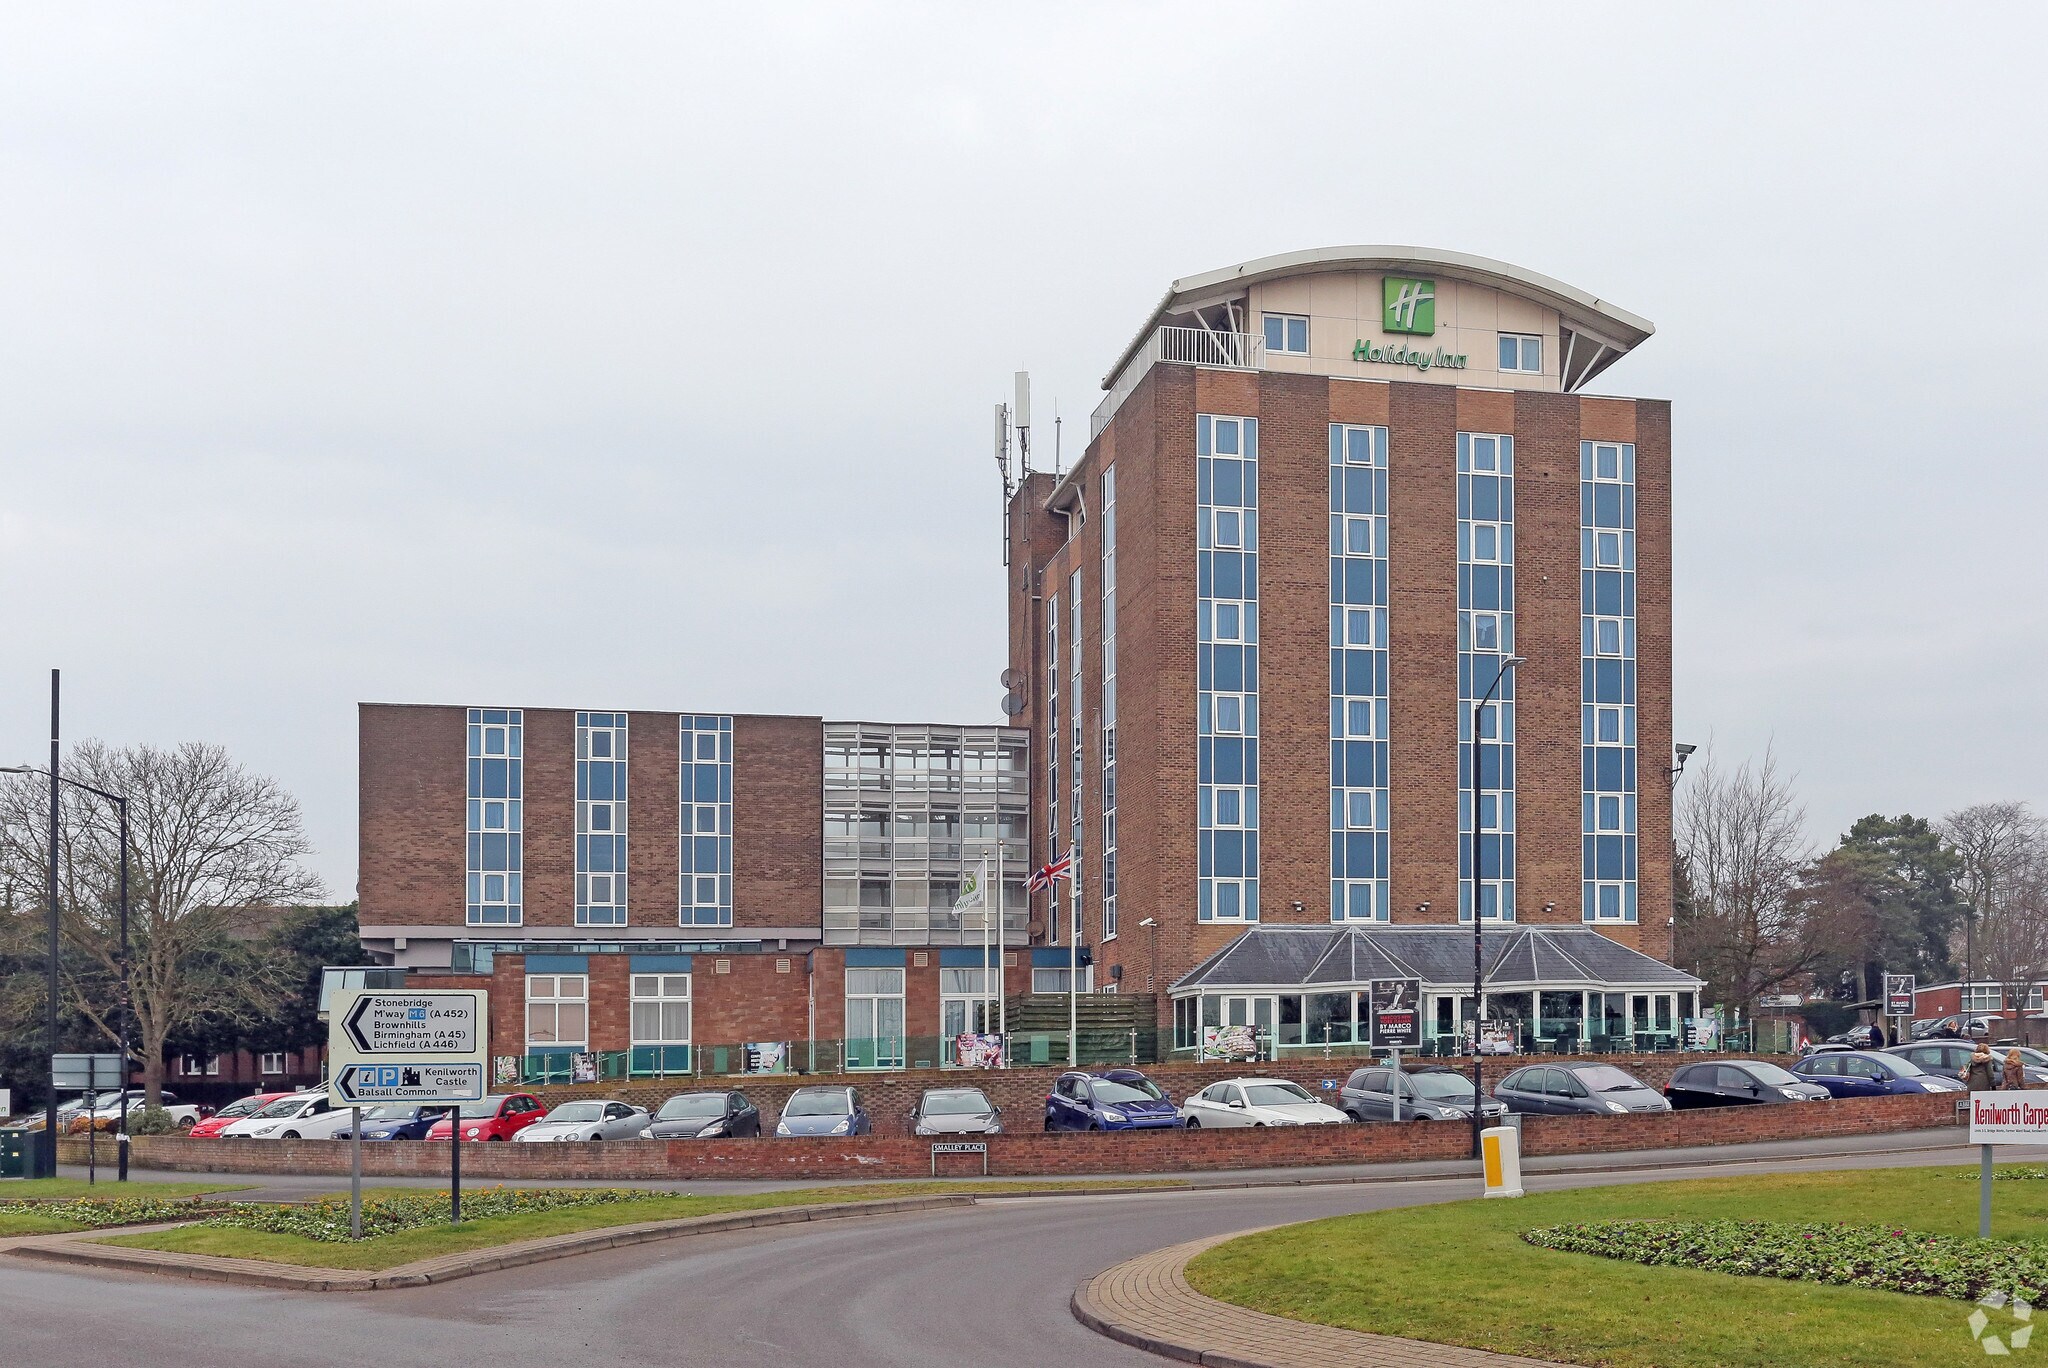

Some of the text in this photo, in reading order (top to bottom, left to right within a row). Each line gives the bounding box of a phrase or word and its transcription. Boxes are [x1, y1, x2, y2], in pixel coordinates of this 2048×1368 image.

[1353, 339, 1468, 371] Holiday Inn
[374, 999, 433, 1008] Stonebridge
[374, 1010, 405, 1019] M'way
[374, 1021, 426, 1029] Brownhills
[374, 1031, 431, 1040] Birmingham
[374, 1041, 416, 1049] Lichfield
[425, 1068, 478, 1076] Kenilworth
[436, 1078, 468, 1086] Castle
[358, 1087, 438, 1097] Balsall Common
[1974, 1099, 2020, 1125] Kenilworth
